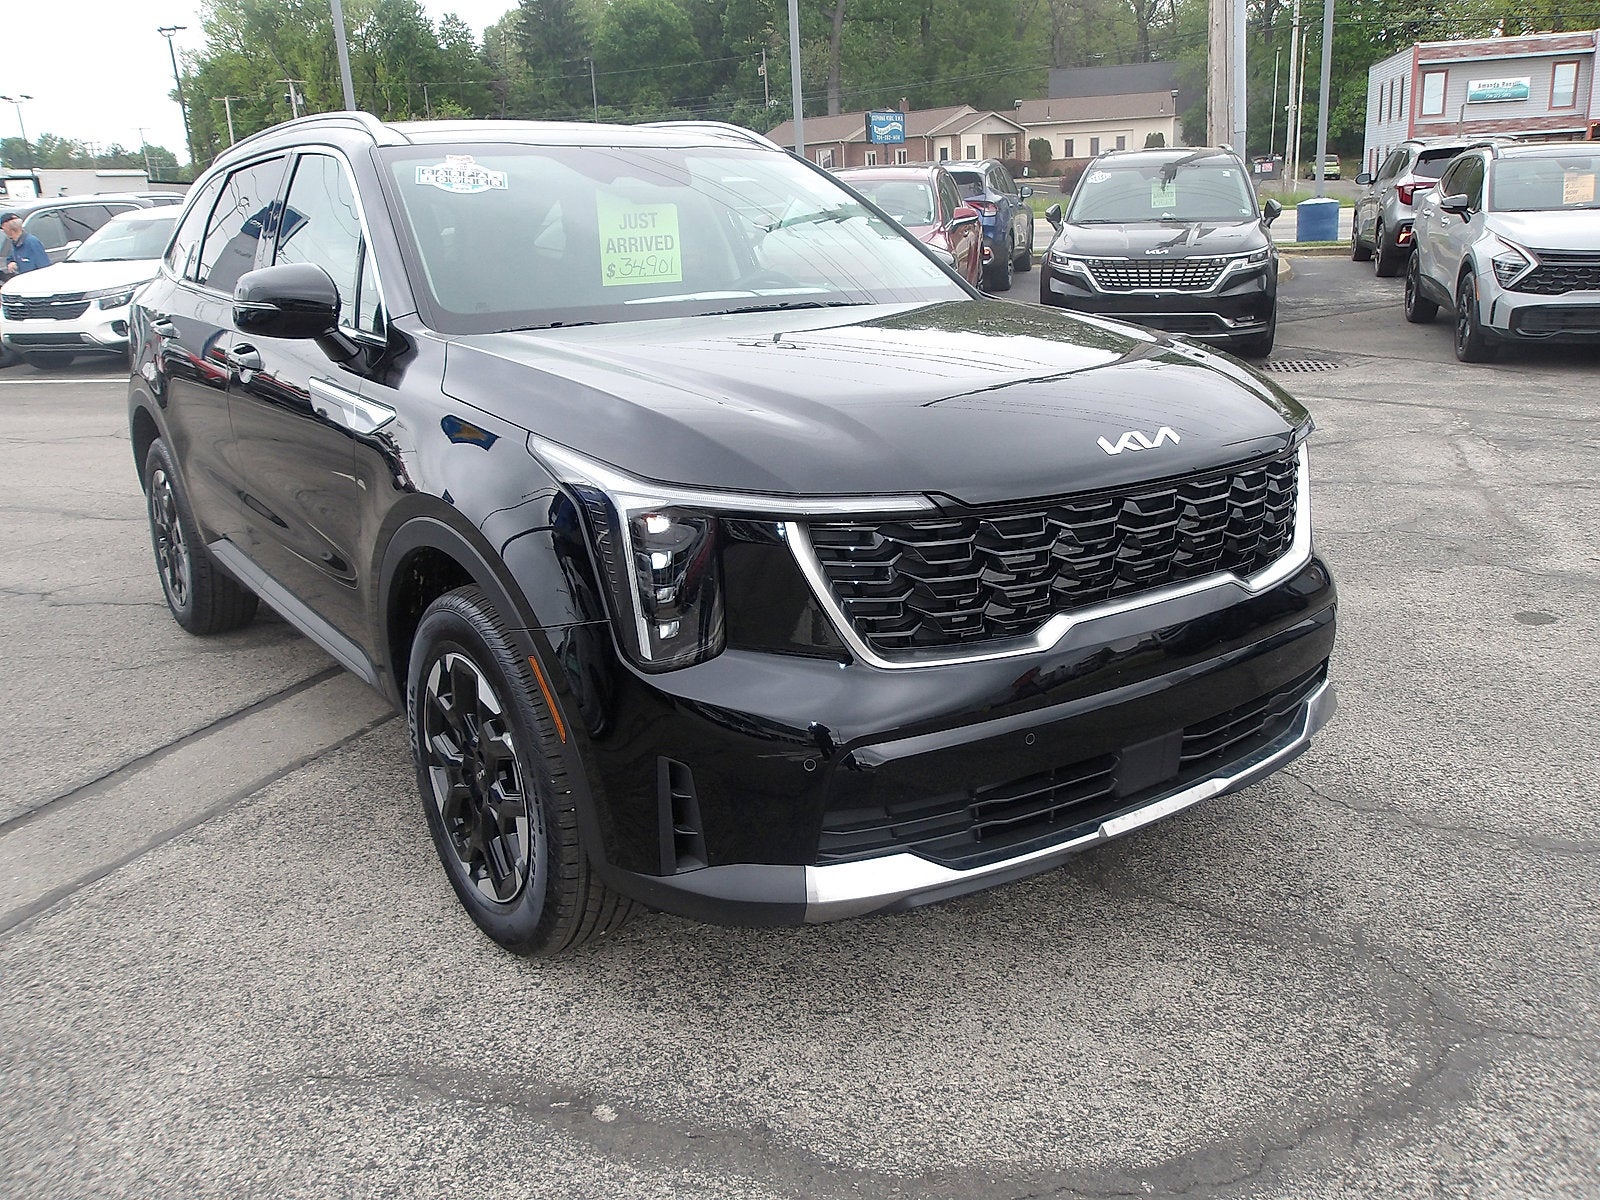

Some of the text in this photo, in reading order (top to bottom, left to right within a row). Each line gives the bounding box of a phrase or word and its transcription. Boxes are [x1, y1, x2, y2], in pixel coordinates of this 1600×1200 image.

[618, 212, 658, 230] JUST
[606, 235, 675, 254] ARRIVED
[1096, 426, 1181, 456] KIA
